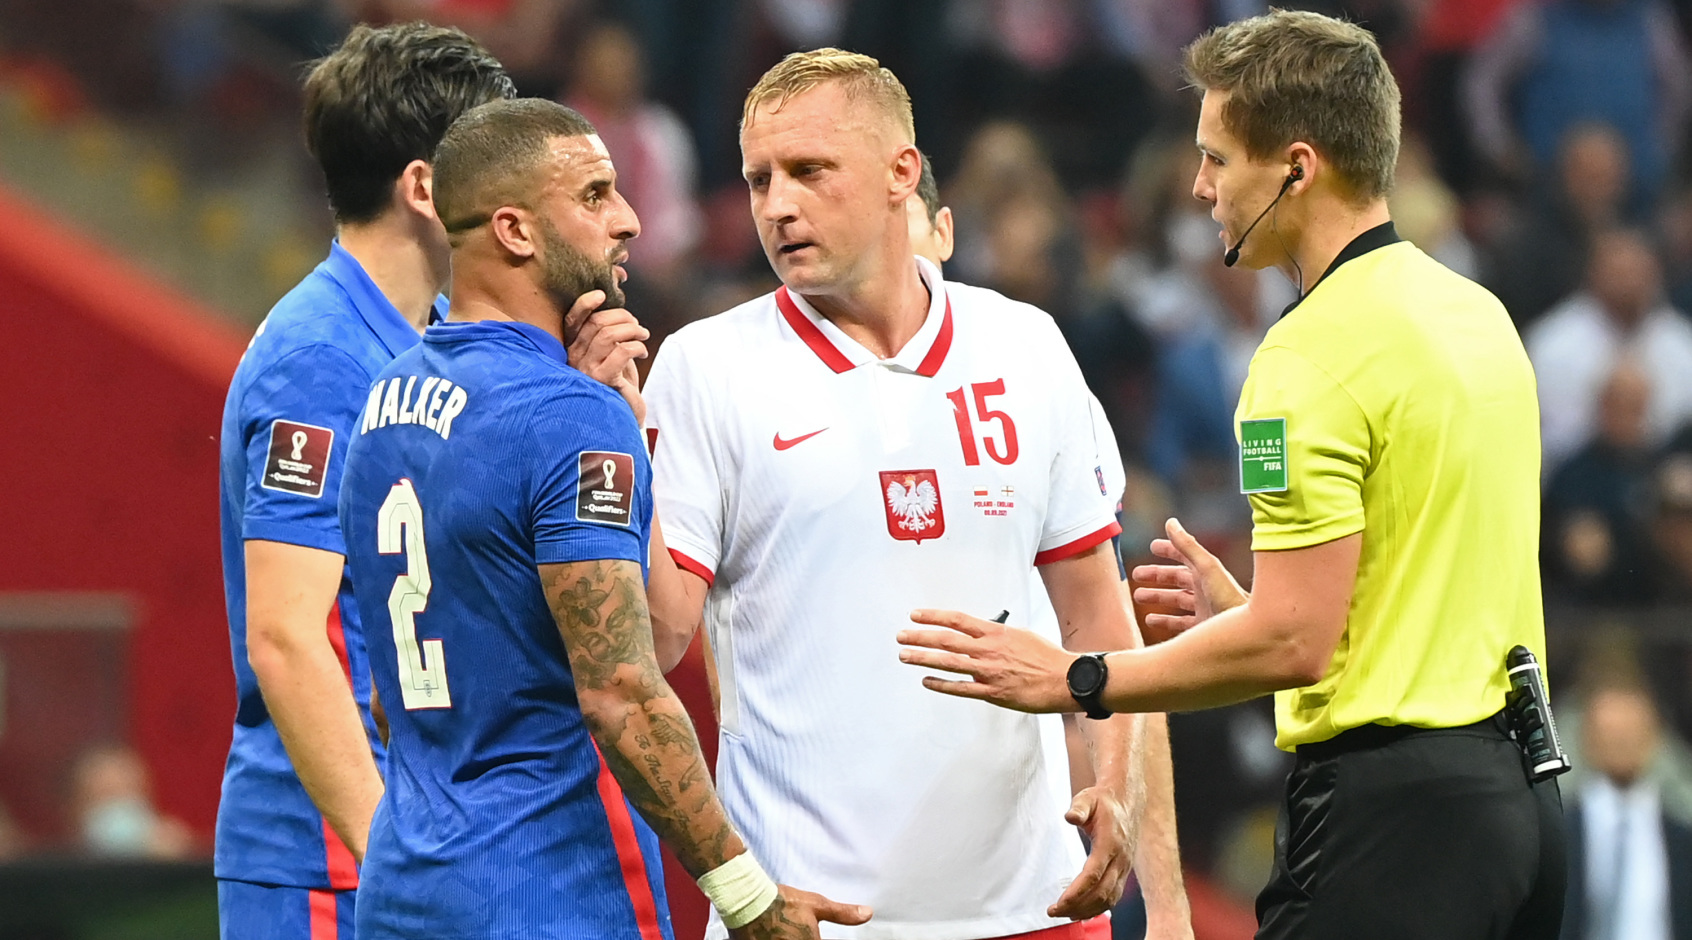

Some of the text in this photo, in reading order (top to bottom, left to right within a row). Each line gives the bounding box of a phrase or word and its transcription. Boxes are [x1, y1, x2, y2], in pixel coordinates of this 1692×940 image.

[360, 375, 468, 440] WALKER
[946, 378, 1019, 466] 15
[1243, 438, 1282, 448] LIVING
[1243, 446, 1282, 456] FOOTBALL
[1263, 462, 1282, 471] FIFA
[588, 503, 624, 515] Qualifiers
[377, 477, 452, 711] 2
